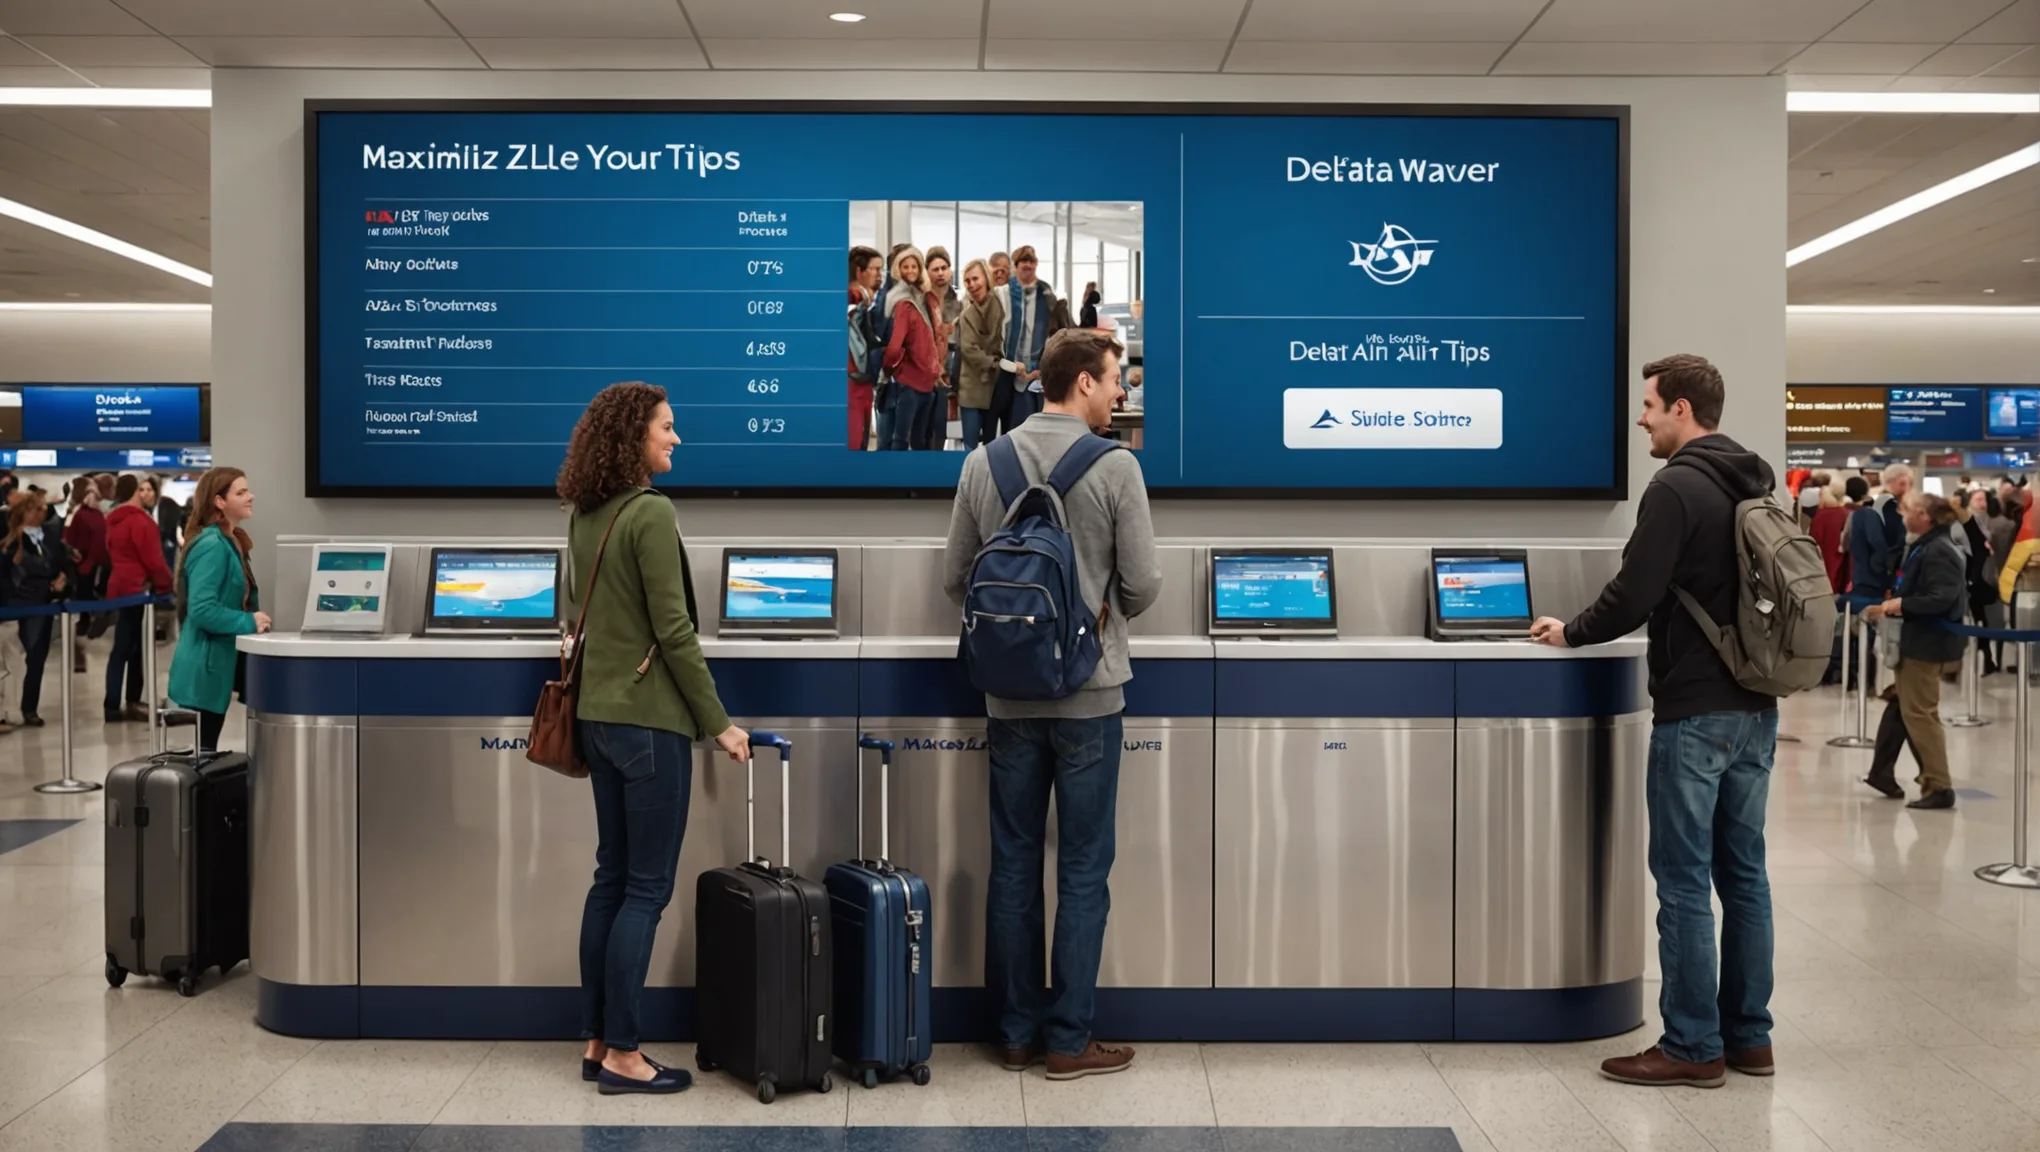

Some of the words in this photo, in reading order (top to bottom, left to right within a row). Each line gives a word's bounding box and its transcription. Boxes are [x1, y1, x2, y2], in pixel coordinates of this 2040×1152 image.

[586, 144, 662, 171] Your
[665, 143, 741, 178] Tips
[1399, 158, 1500, 183] Waver
[1441, 340, 1490, 368] Tips
